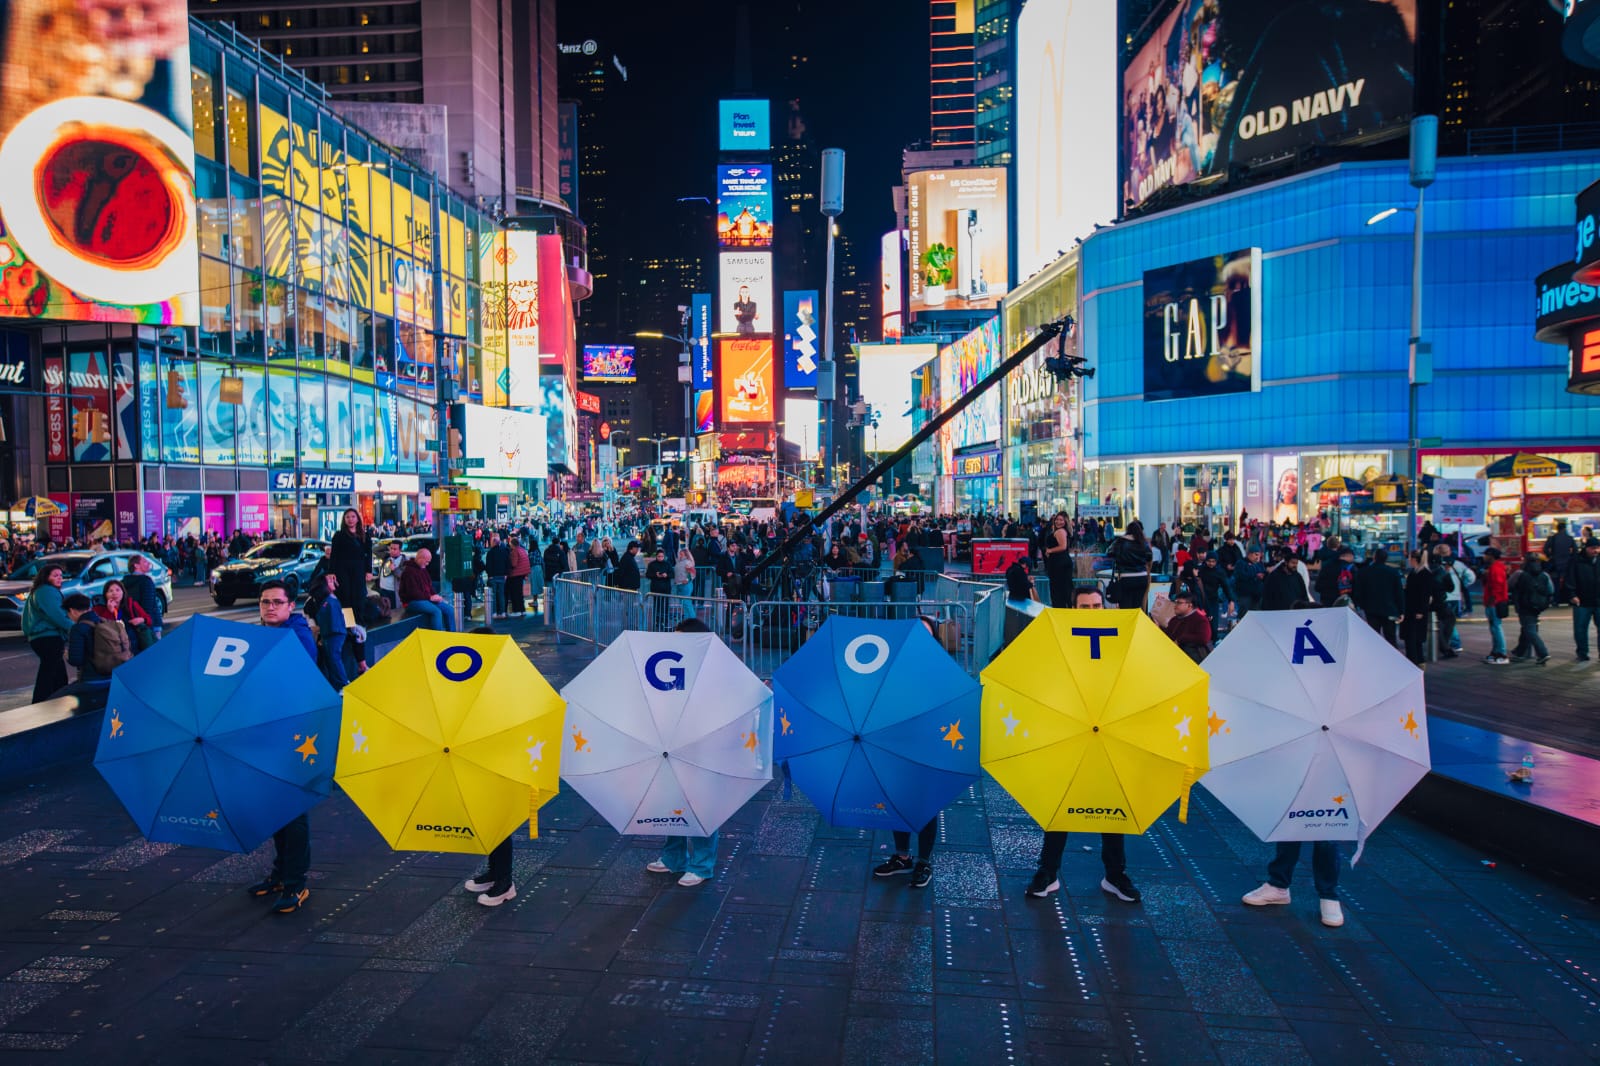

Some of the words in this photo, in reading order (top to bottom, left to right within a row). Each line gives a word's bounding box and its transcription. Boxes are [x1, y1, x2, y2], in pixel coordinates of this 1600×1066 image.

[1239, 105, 1288, 140] OLD
[1291, 78, 1365, 125] NAVY
[559, 114, 572, 194] TIMES
[911, 185, 919, 208] dust
[1138, 174, 1154, 201] OLD
[1154, 154, 1177, 190] NAVY
[911, 211, 919, 227] the
[911, 230, 920, 270] empties
[1541, 281, 1600, 317] inves
[1163, 294, 1227, 362] GAP
[1011, 374, 1029, 406] OLD
[50, 413, 61, 444] CBS
[143, 409, 151, 440] CBS
[204, 636, 250, 676] B
[844, 634, 890, 674] O
[1072, 628, 1118, 660] T
[1292, 619, 1336, 664] Á
[436, 646, 482, 682] O
[645, 651, 685, 691] G
